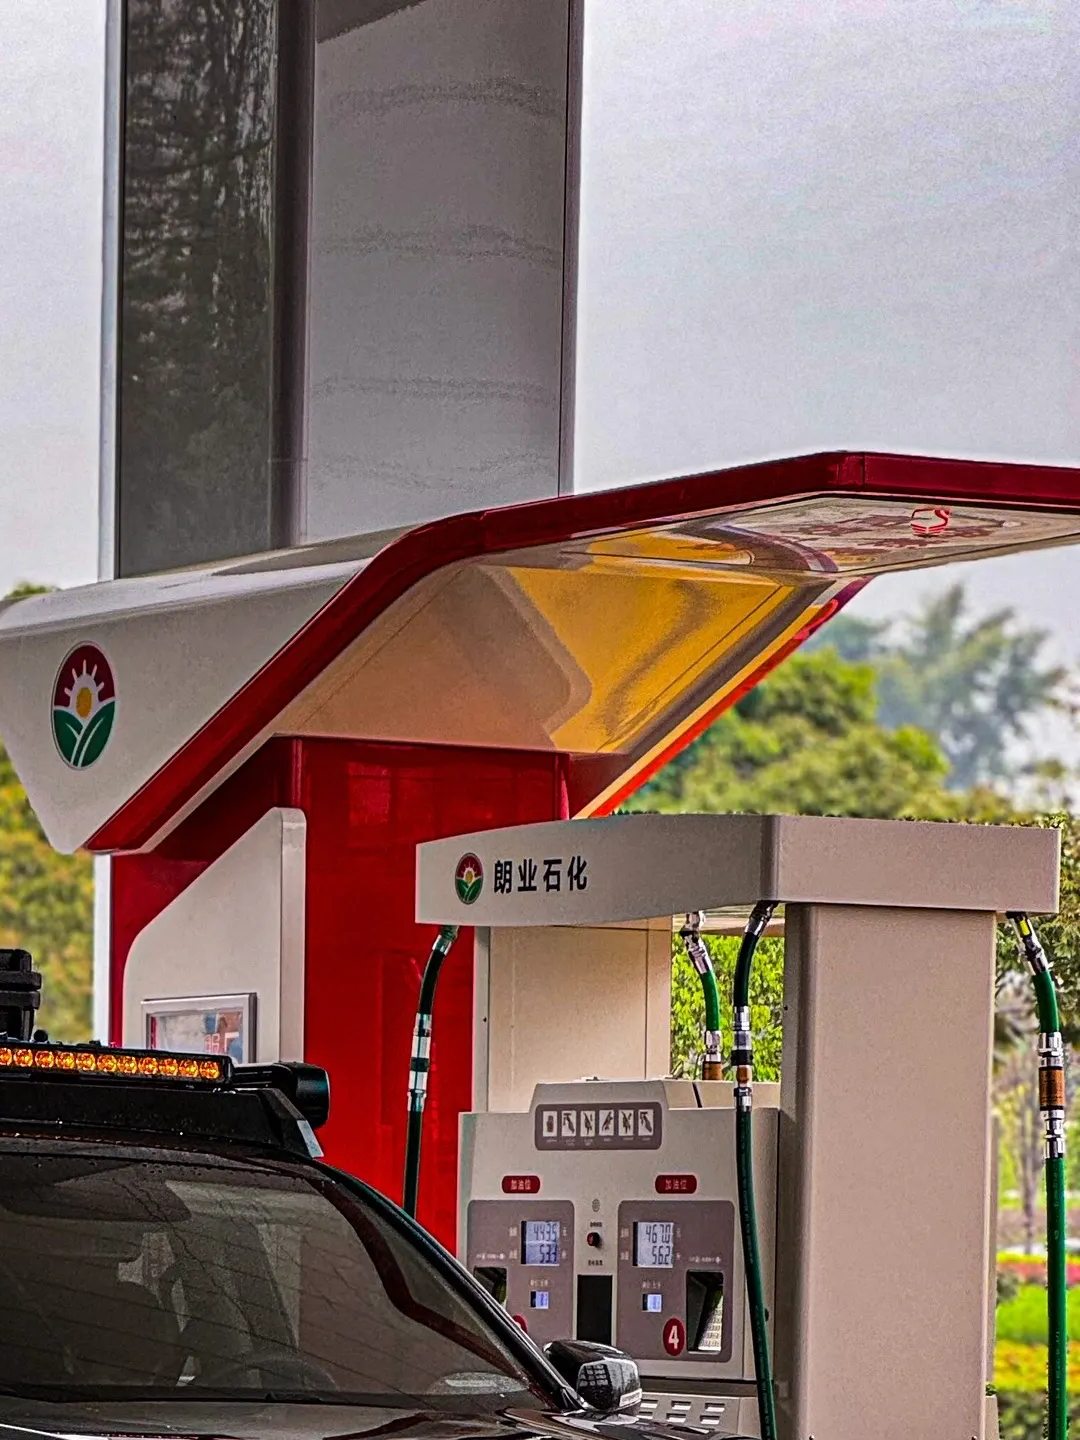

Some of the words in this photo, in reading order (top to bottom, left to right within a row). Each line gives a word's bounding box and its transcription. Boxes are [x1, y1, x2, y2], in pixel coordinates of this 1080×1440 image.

[493, 855, 588, 895] 朗业石化
[668, 1325, 680, 1350] 4
